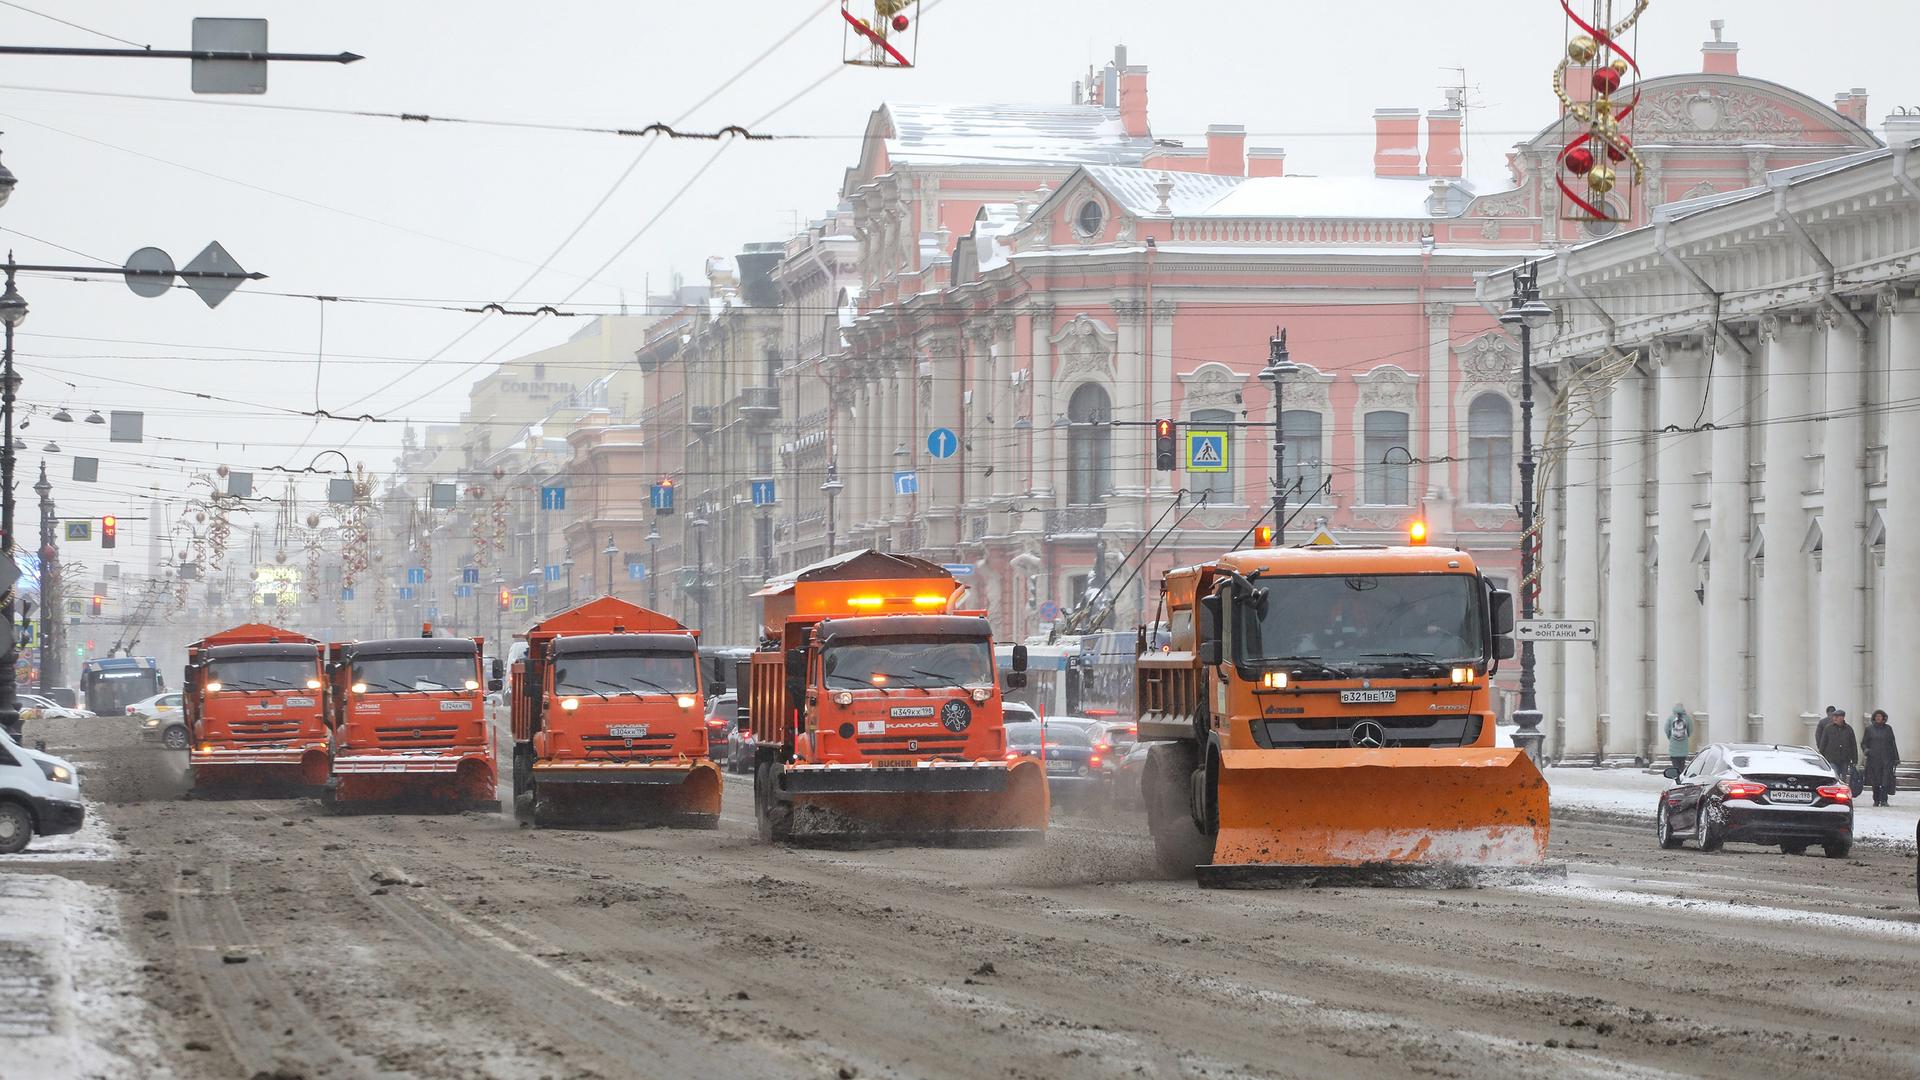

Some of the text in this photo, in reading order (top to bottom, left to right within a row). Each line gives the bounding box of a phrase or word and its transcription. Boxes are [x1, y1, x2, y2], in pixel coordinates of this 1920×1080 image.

[500, 382, 578, 393] CORINTHIA
[1343, 691, 1395, 701] В321ВЕ 178
[893, 708, 920, 716] Н349КХ
[878, 760, 912, 768] BUCHER
